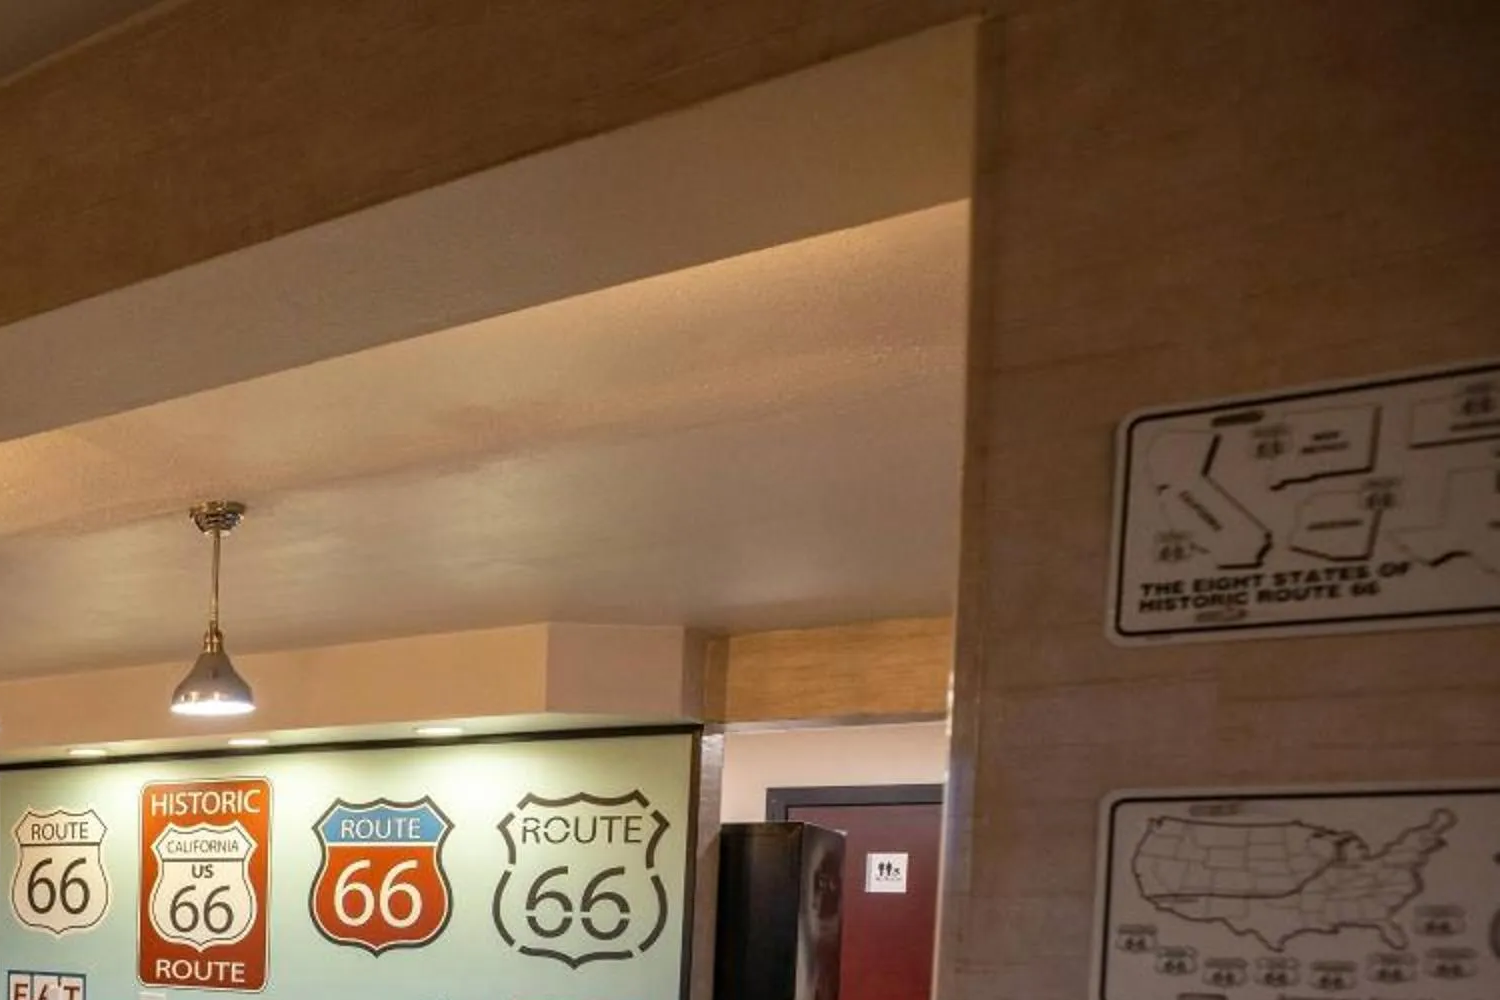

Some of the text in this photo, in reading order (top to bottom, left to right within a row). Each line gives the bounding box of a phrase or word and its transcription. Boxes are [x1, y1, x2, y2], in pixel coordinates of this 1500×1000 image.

[1140, 561, 1412, 598] THE EIGHT STATES OF
[1138, 590, 1249, 613] HISTORIC
[1256, 584, 1341, 605] ROUTE
[151, 788, 261, 816] HISTORIC
[30, 821, 89, 841] ROUTE
[340, 816, 421, 841] ROUTE
[521, 815, 643, 845] ROUTE
[166, 838, 240, 855] CALIFORNIA
[191, 863, 214, 879] US
[27, 857, 91, 915] 66
[333, 858, 423, 929] 66
[170, 884, 235, 934] 66
[525, 865, 631, 940] 66
[156, 958, 245, 983] ROUTE
